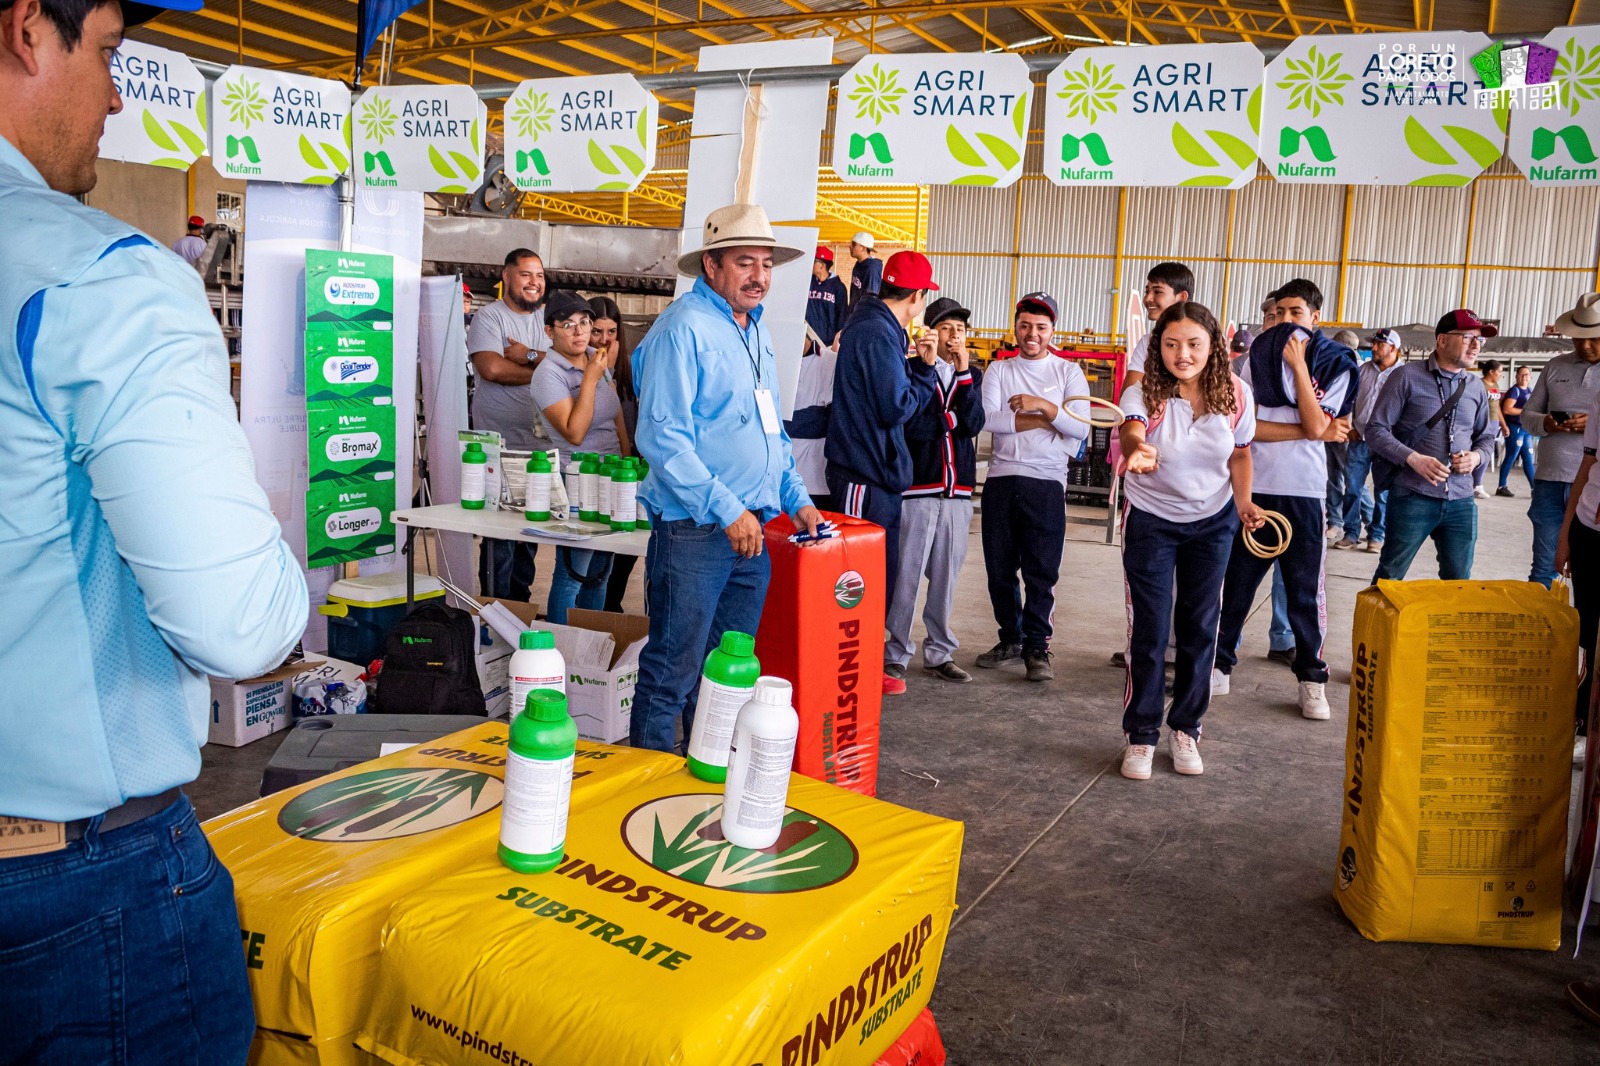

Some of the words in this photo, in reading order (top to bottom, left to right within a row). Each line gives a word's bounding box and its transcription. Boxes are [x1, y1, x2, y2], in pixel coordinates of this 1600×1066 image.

[109, 54, 169, 83] AGRI
[1133, 62, 1212, 87] AGRI
[914, 70, 984, 91] AGRI
[273, 86, 322, 109] AGRI
[560, 90, 613, 111] AGRI
[913, 94, 1015, 117] SMART
[1132, 88, 1249, 114] SMART
[402, 100, 449, 117] AGRI
[273, 106, 343, 132] SMART
[403, 119, 471, 138] SMART
[560, 110, 638, 133] SMART
[226, 162, 262, 175] Nufarm
[848, 163, 894, 178] Nufarm
[1061, 166, 1113, 181] Nufarm
[1278, 162, 1337, 177] Nufarm
[1530, 165, 1598, 181] Nufarm
[365, 176, 398, 188] Nufarm
[516, 176, 552, 188] Nufarm
[342, 289, 375, 300] Extremo
[338, 519, 371, 533] Longer
[246, 692, 252, 700] SI
[252, 683, 276, 698] PIENSAS
[276, 680, 284, 688] EN
[584, 677, 608, 687] Nufarm
[246, 696, 277, 717] PIENSA
[1367, 650, 1379, 743] SUBSTRATE
[246, 714, 259, 727] EN
[1498, 911, 1535, 919] PINDSTRUP
[496, 886, 692, 972] SUBSTRATE
[782, 914, 933, 1066] PINDSTRUP
[859, 966, 924, 1047] SUBSTRATE
